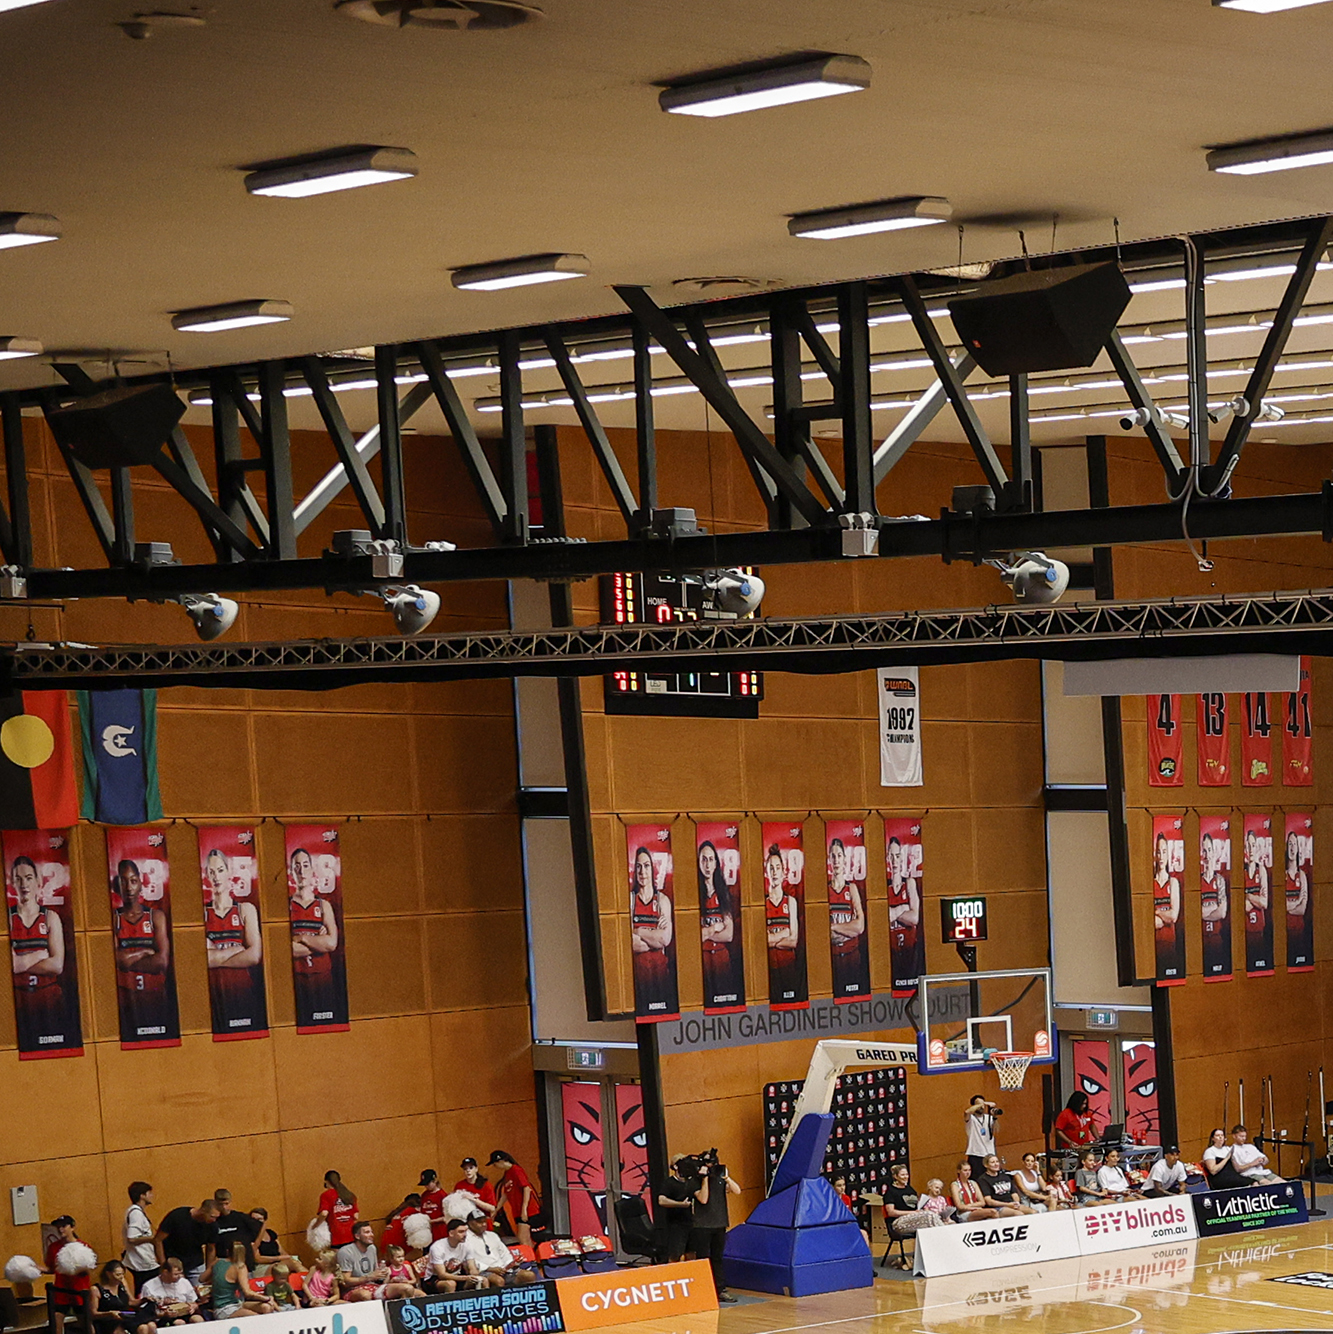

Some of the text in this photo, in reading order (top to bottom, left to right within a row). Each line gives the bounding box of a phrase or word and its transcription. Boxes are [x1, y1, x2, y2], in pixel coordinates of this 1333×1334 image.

[887, 707, 915, 730] 1992
[1156, 693, 1176, 736] 4
[1201, 692, 1226, 737] 13
[1245, 692, 1271, 738] 14
[952, 901, 984, 919] 10:00
[954, 918, 977, 938] 24
[673, 1017, 732, 1046] JOHN
[738, 1006, 842, 1037] GARDINER
[856, 1049, 918, 1063] GARED PR
[971, 1225, 1030, 1246] BASE
[1150, 1225, 1188, 1239] .com.au
[425, 1288, 547, 1316] RETRIEVER SOUND
[581, 1278, 692, 1312] CYGNETT
[427, 1301, 550, 1329] DJ SERVICES
